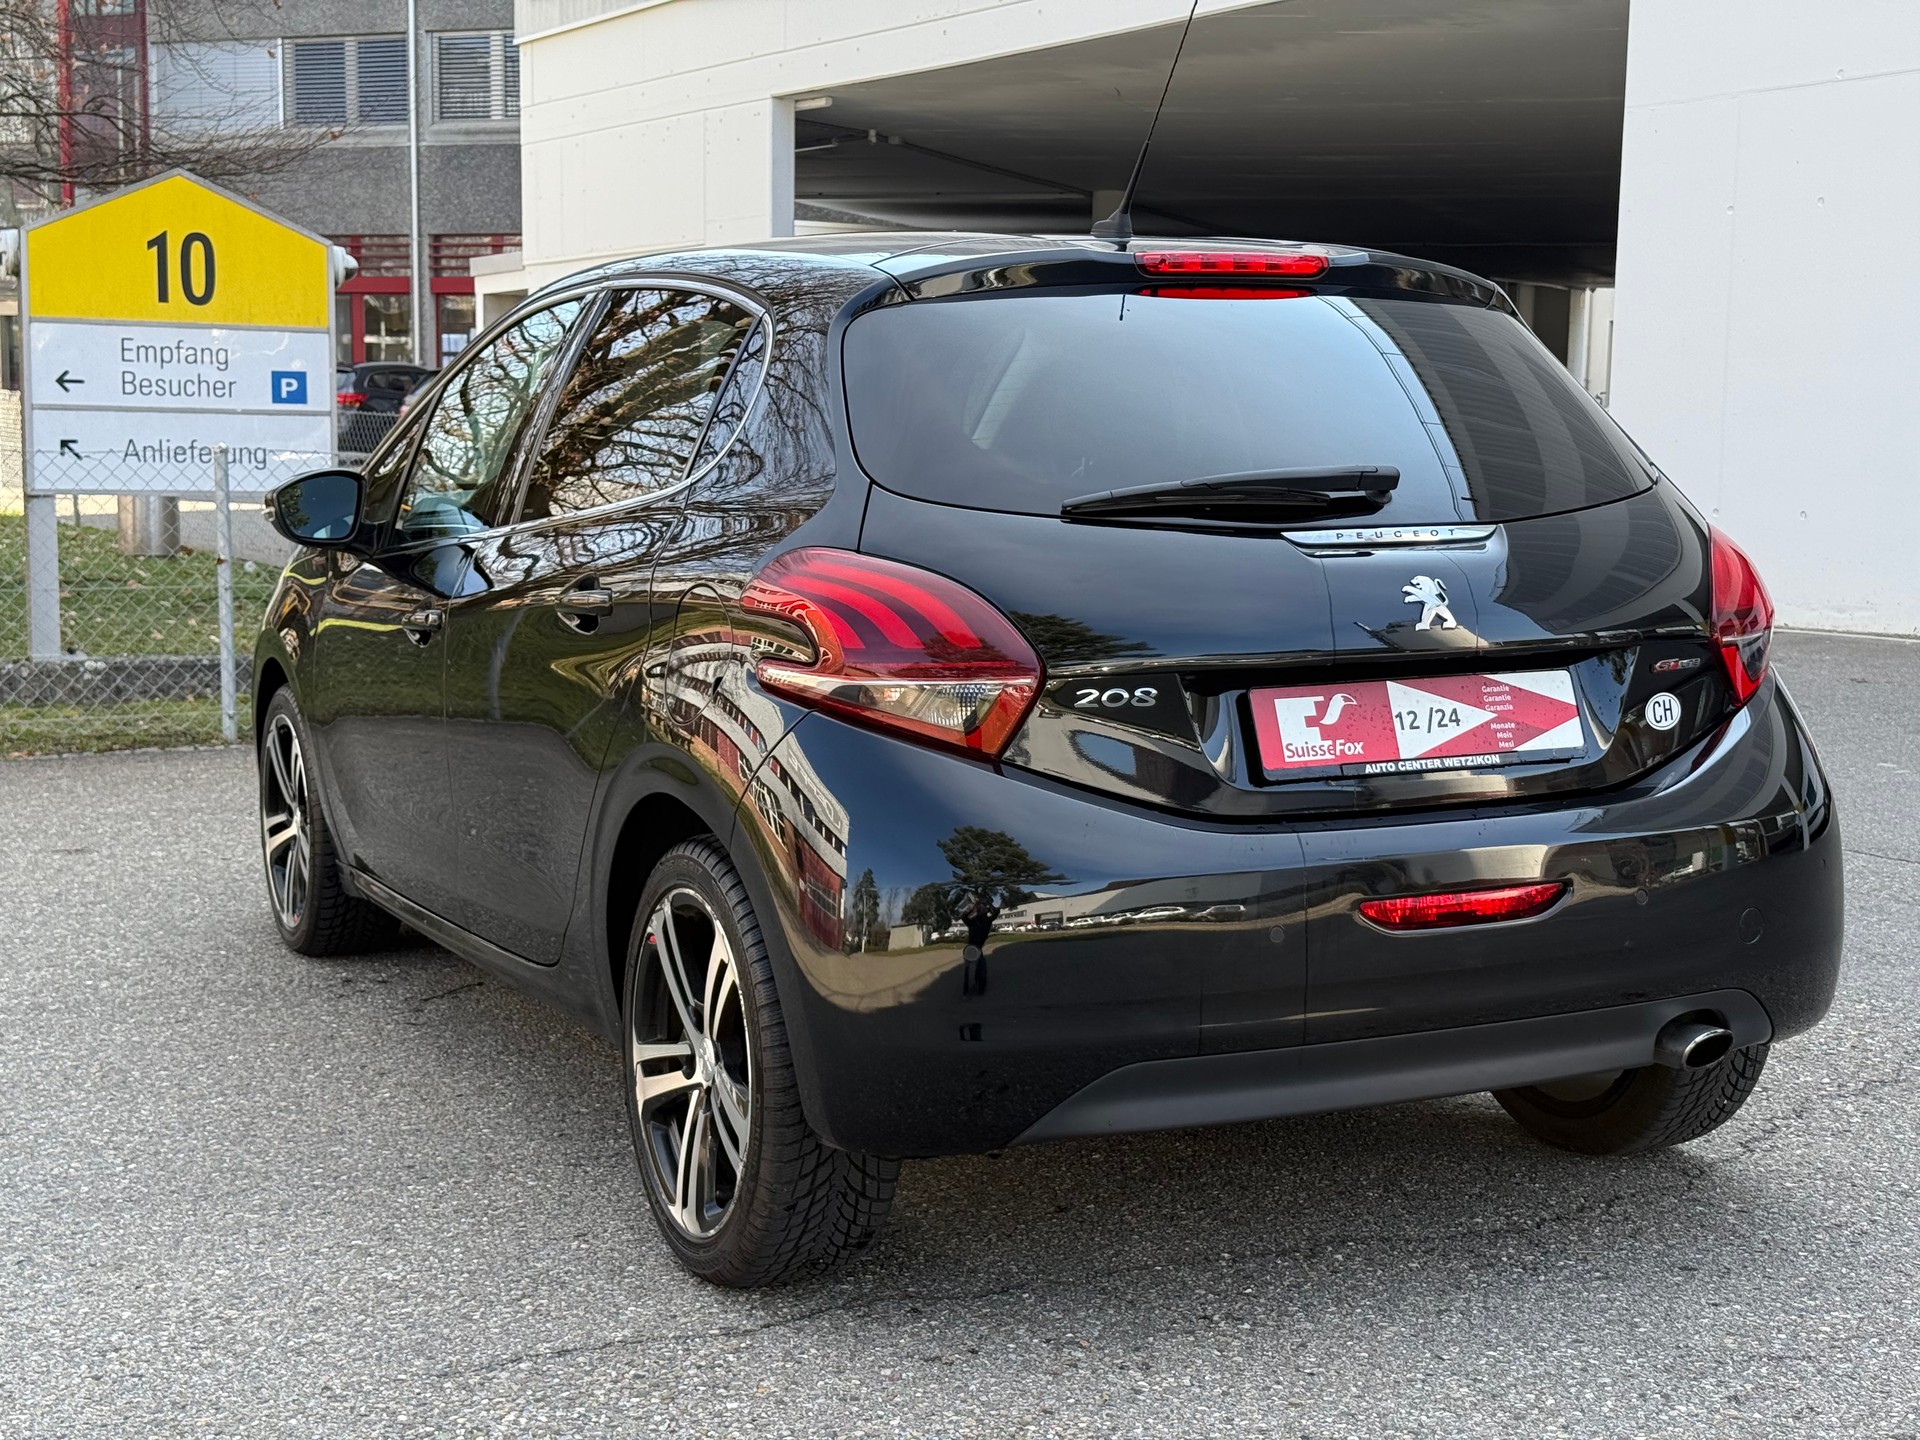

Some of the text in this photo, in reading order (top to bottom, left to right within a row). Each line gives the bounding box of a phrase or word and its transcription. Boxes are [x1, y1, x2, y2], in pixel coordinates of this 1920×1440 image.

[146, 230, 216, 306] 10
[120, 338, 229, 371] Empfang
[121, 371, 237, 399] Besucher
[280, 377, 299, 399] P
[122, 438, 267, 471] Anliefeung
[1336, 528, 1456, 540] PEUGEOT
[1073, 687, 1158, 708] 208
[1481, 684, 1510, 693] Garantie
[1483, 694, 1512, 702] Garantie
[1485, 703, 1514, 711] Garanzia
[1652, 699, 1674, 724] CH
[1490, 722, 1516, 730] Monate
[1497, 731, 1513, 739] Mois
[1285, 739, 1364, 759] SuisseFox
[1499, 740, 1515, 748] Mesi
[1365, 754, 1501, 773] AUTO CENTER WETZIKON
